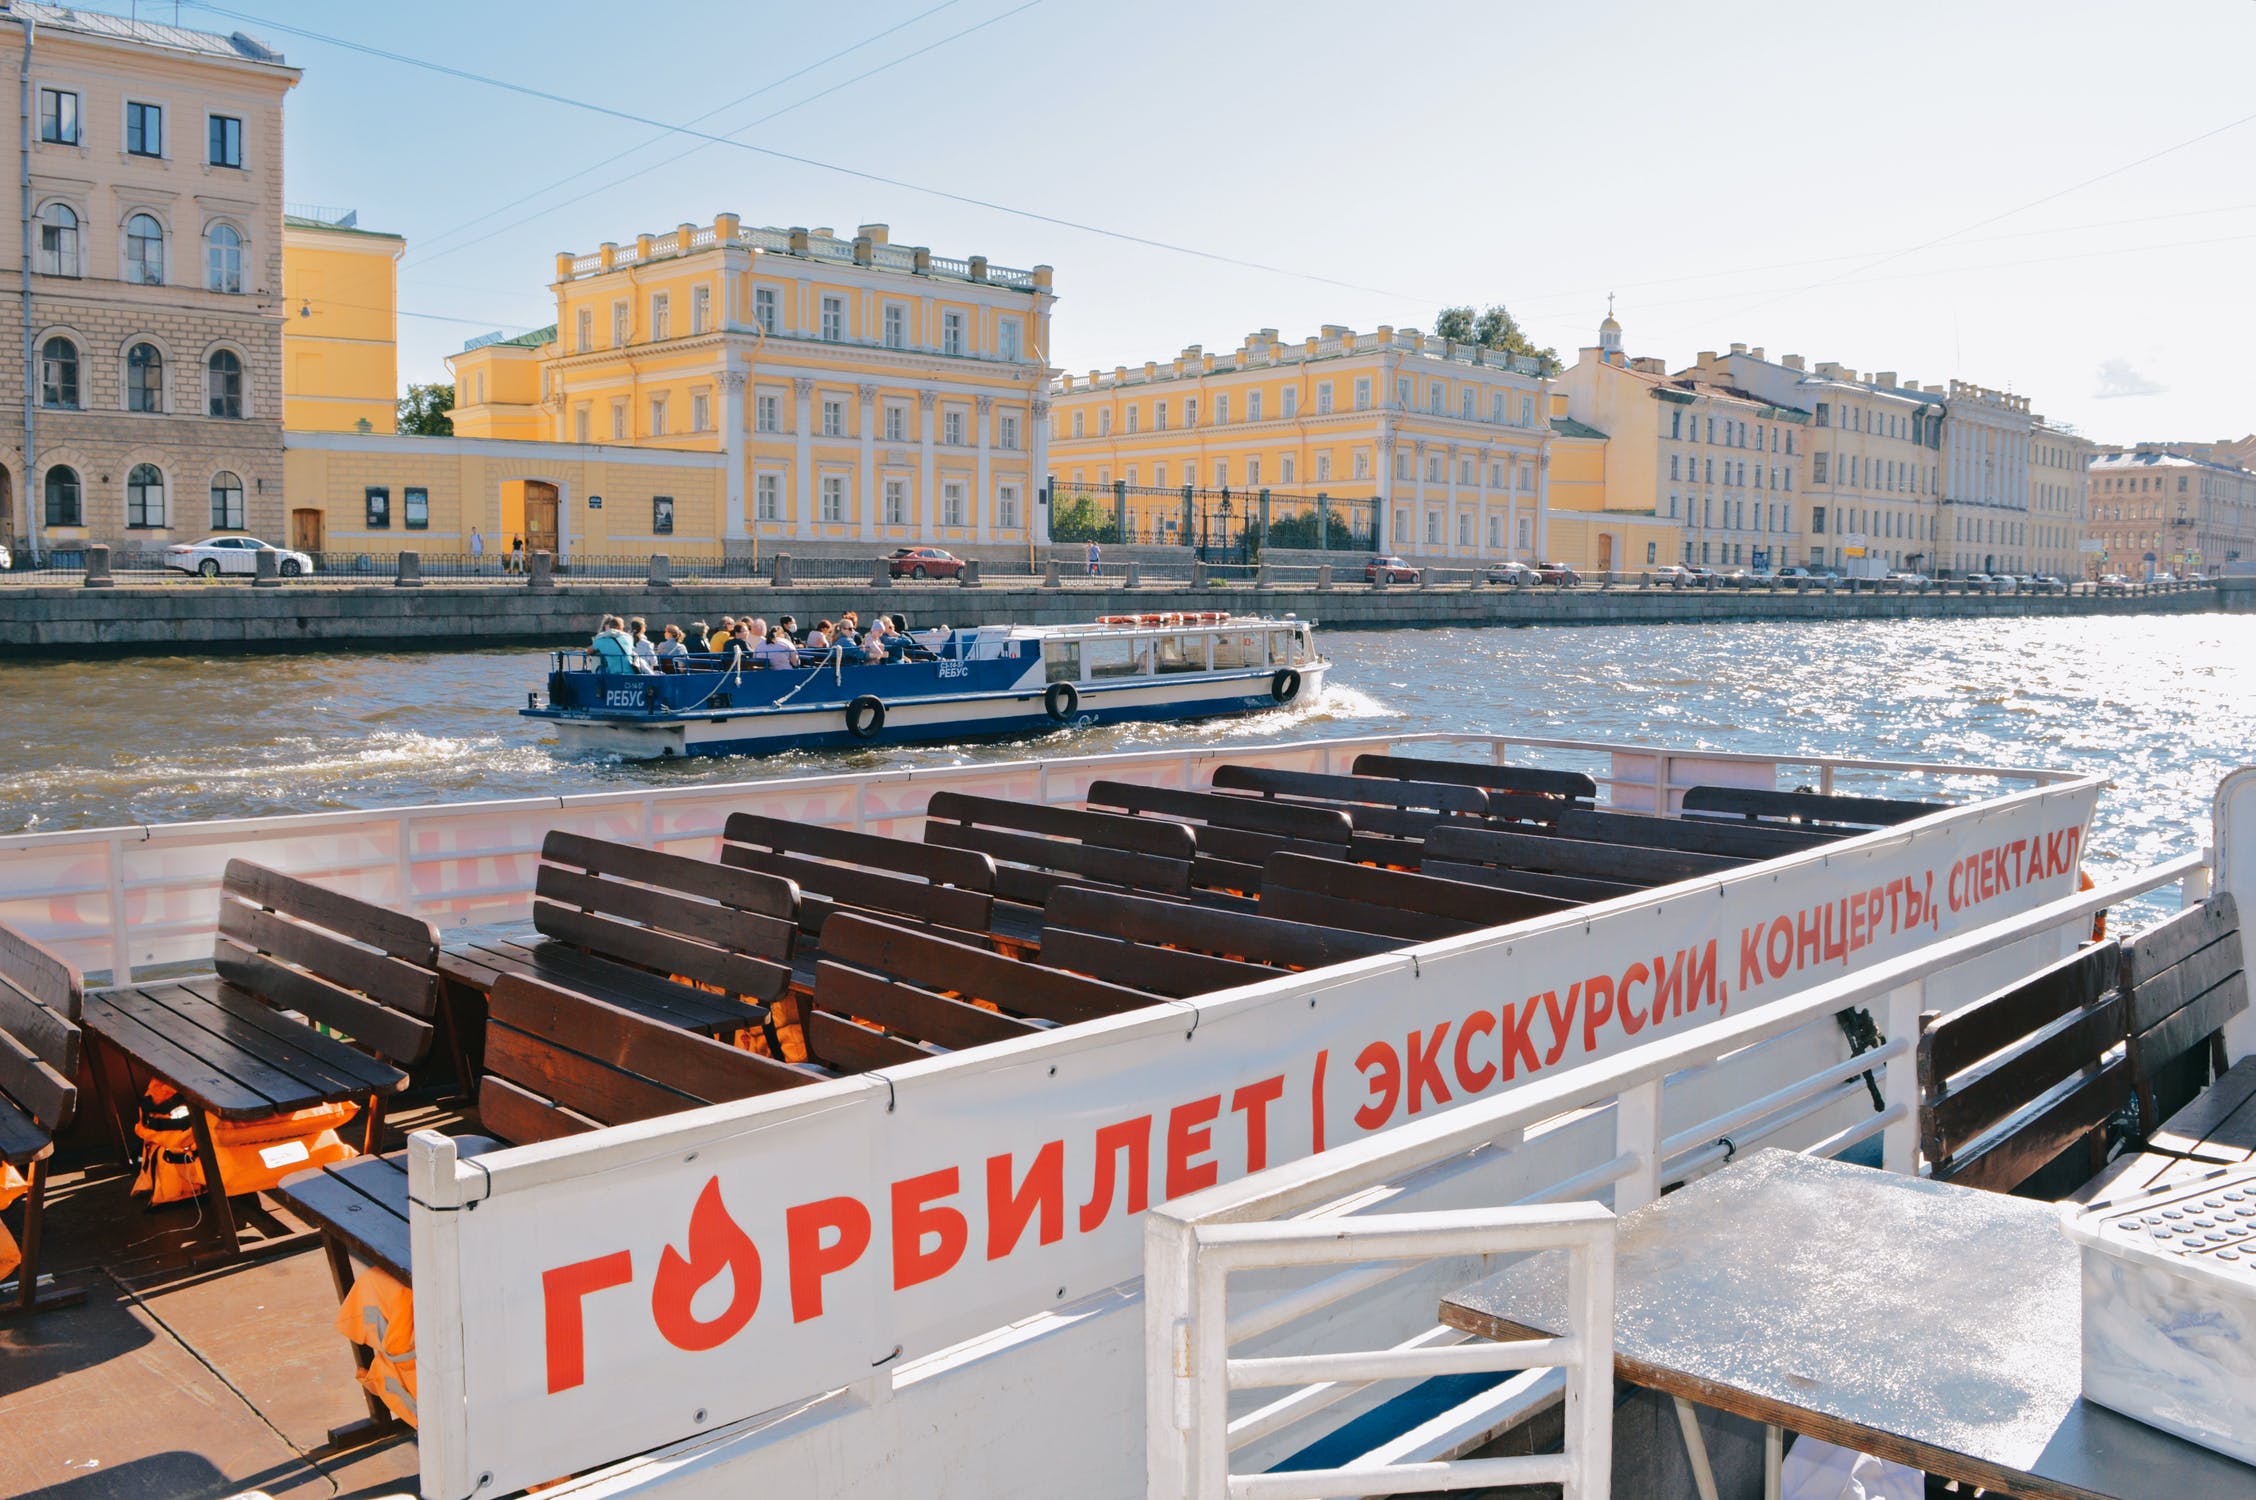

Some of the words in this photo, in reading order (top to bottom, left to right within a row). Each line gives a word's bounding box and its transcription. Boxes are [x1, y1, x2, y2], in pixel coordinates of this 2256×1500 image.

[939, 667, 968, 678] РЕБУС
[606, 690, 645, 707] РЕБУС
[1354, 939, 1728, 1131] ЭКСКУРСИИ,
[1739, 870, 1939, 992] КОНЦЕРТЫ,
[1948, 824, 2085, 913] СПЕКТАКЛ
